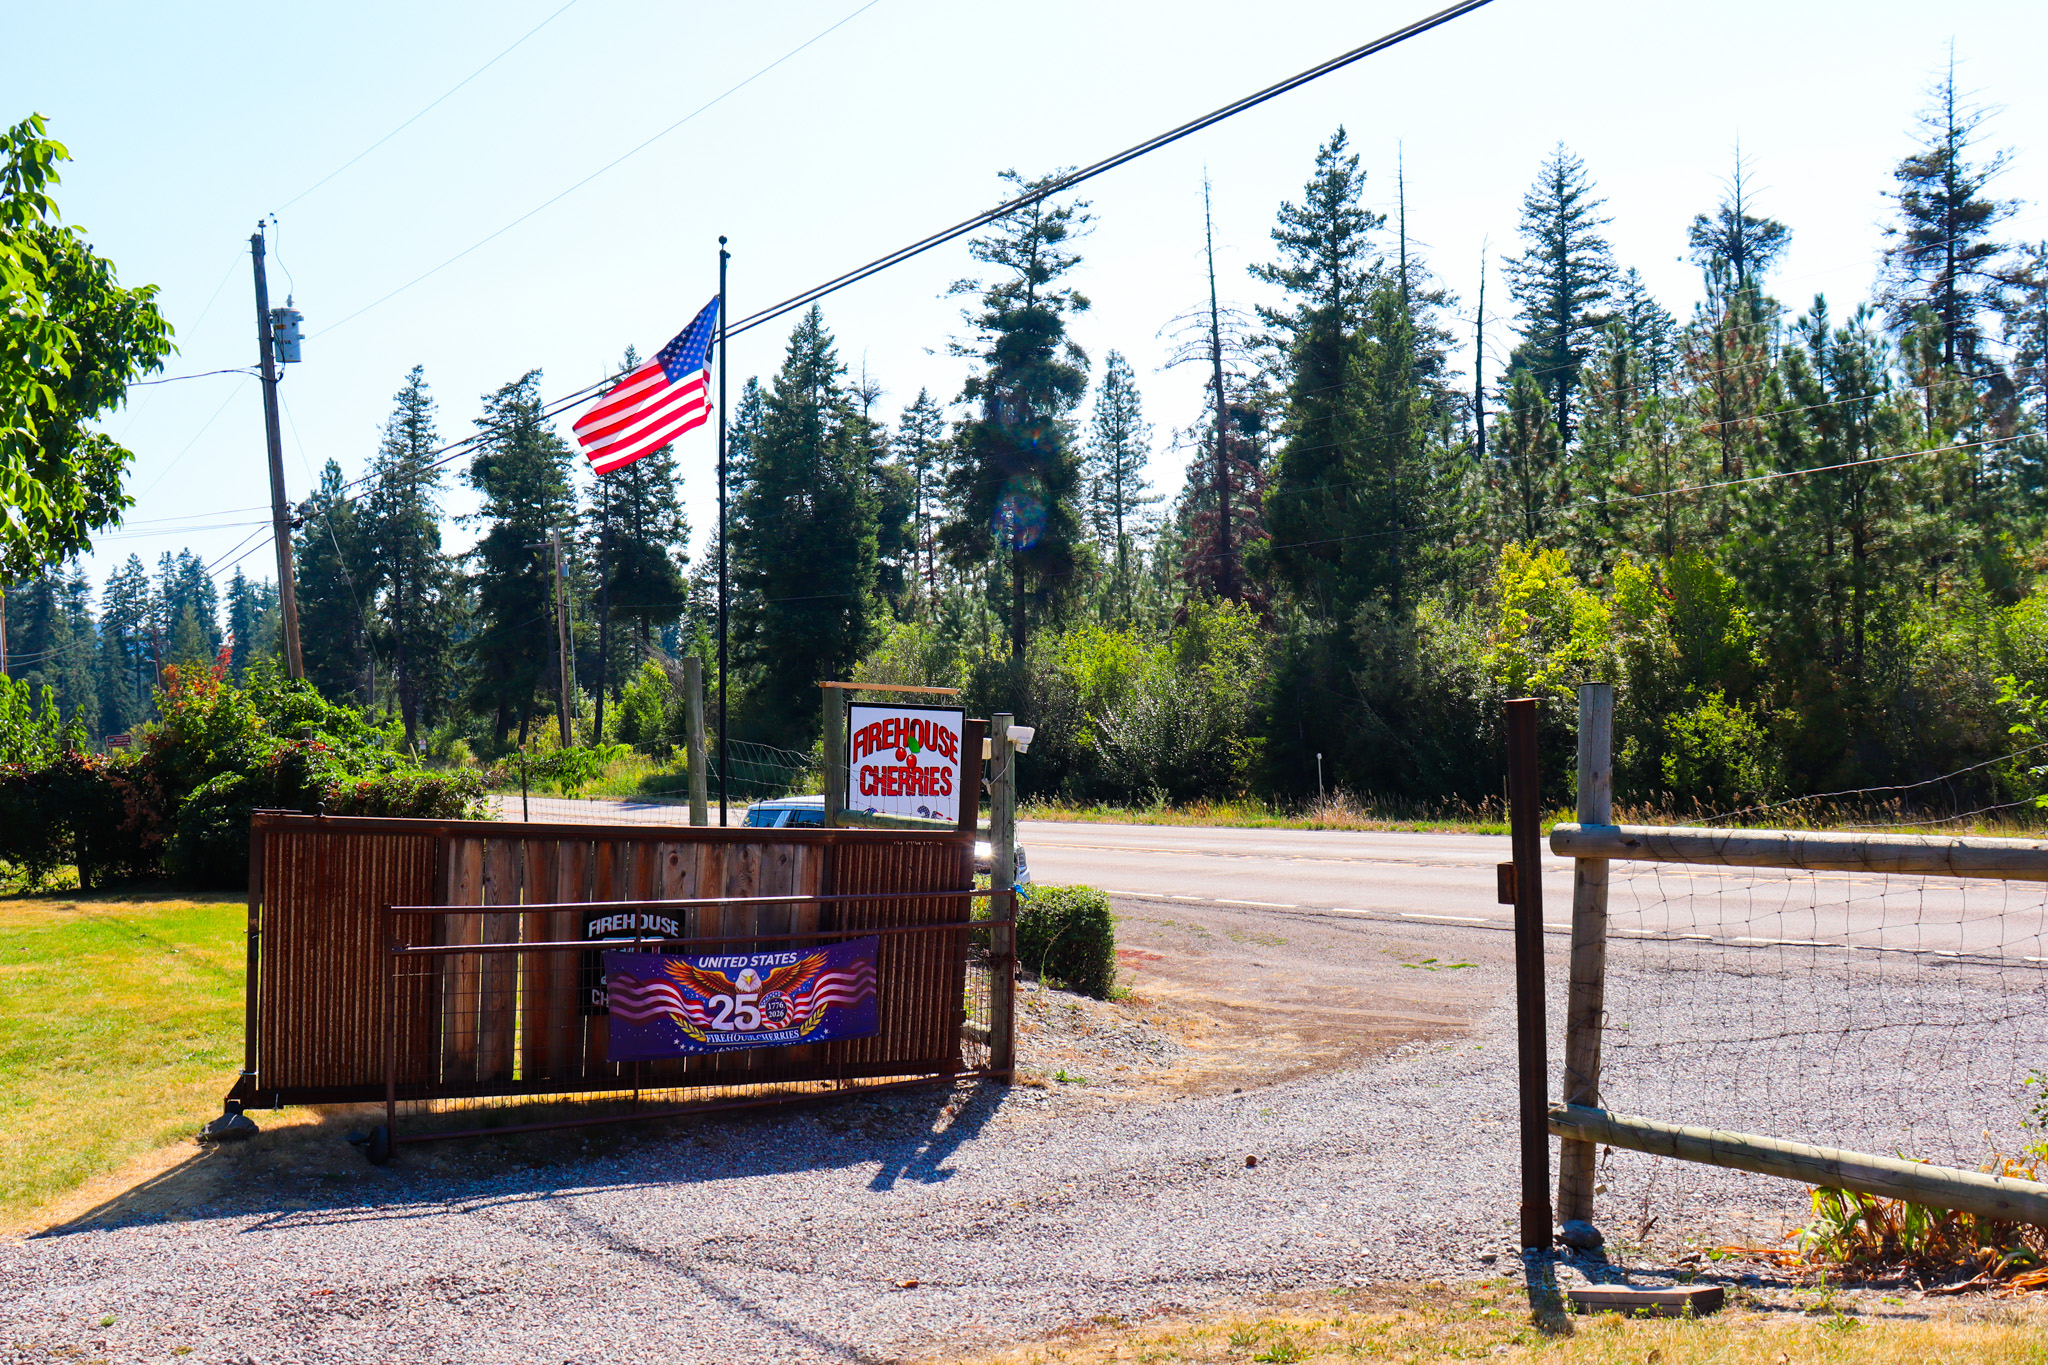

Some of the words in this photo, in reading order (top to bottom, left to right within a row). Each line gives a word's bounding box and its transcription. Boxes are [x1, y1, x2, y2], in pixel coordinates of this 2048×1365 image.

[853, 717, 959, 766] FIREHOUSE
[859, 765, 953, 797] CHERRIES
[698, 956, 748, 968] UNITED
[749, 952, 798, 967] STATES
[768, 1009, 785, 1018] 2026
